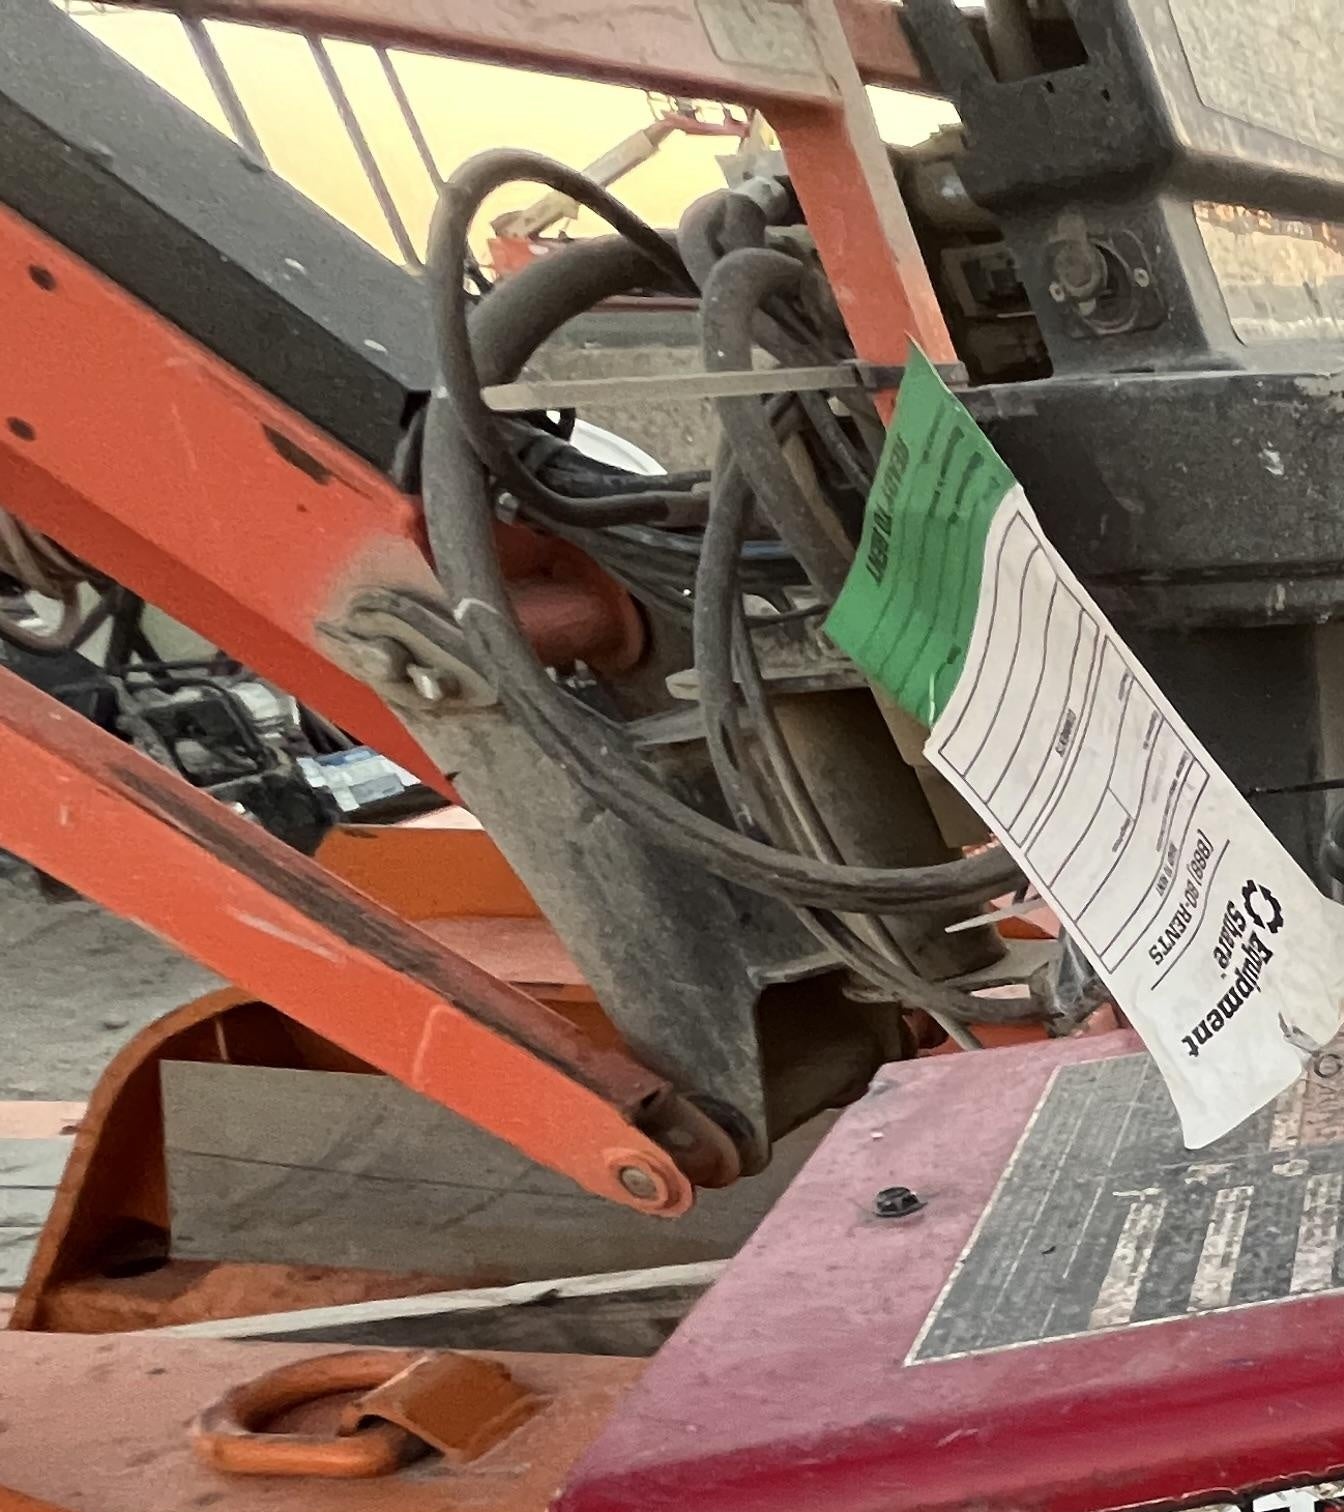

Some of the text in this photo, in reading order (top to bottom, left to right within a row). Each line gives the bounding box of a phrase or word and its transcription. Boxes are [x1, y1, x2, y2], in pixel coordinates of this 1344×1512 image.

[1187, 829, 1214, 887] (888)
[1148, 880, 1201, 965] 80-RENTS
[1213, 899, 1248, 970] Share
[1181, 930, 1274, 1057] Equipment
